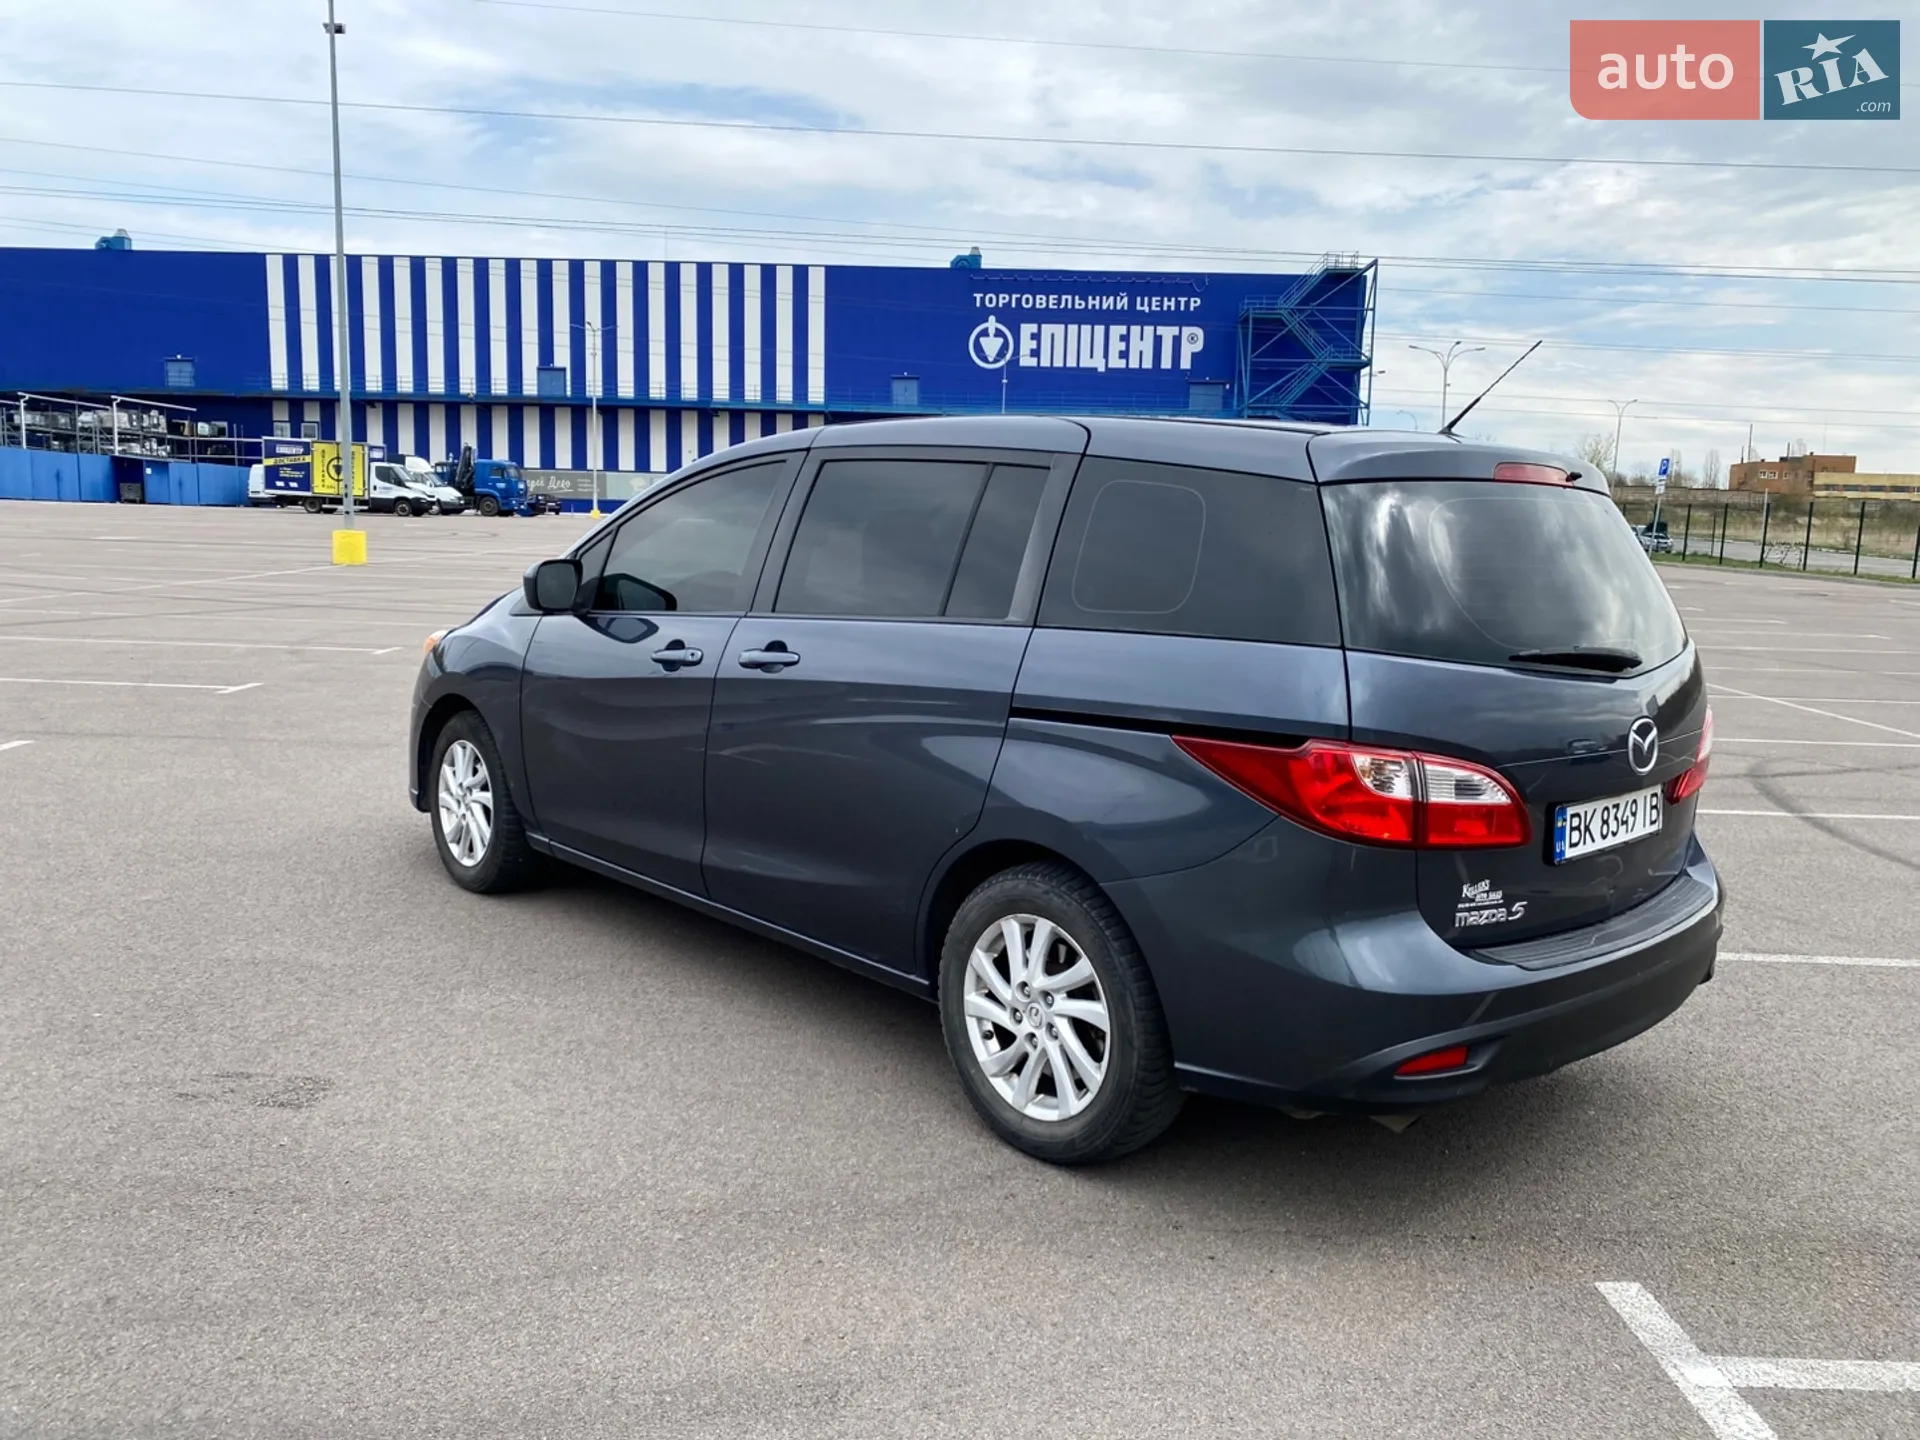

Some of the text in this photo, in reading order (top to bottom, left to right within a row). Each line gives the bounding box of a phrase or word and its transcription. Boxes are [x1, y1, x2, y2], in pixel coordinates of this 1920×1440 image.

[973, 292, 1201, 313] ТОРГОВЕЛЬНИЙ ЦЕНТР
[1019, 323, 1205, 372] ЕПІЦЕНТР
[1569, 792, 1660, 848] BK 8349 IB
[1508, 901, 1528, 920] 5
